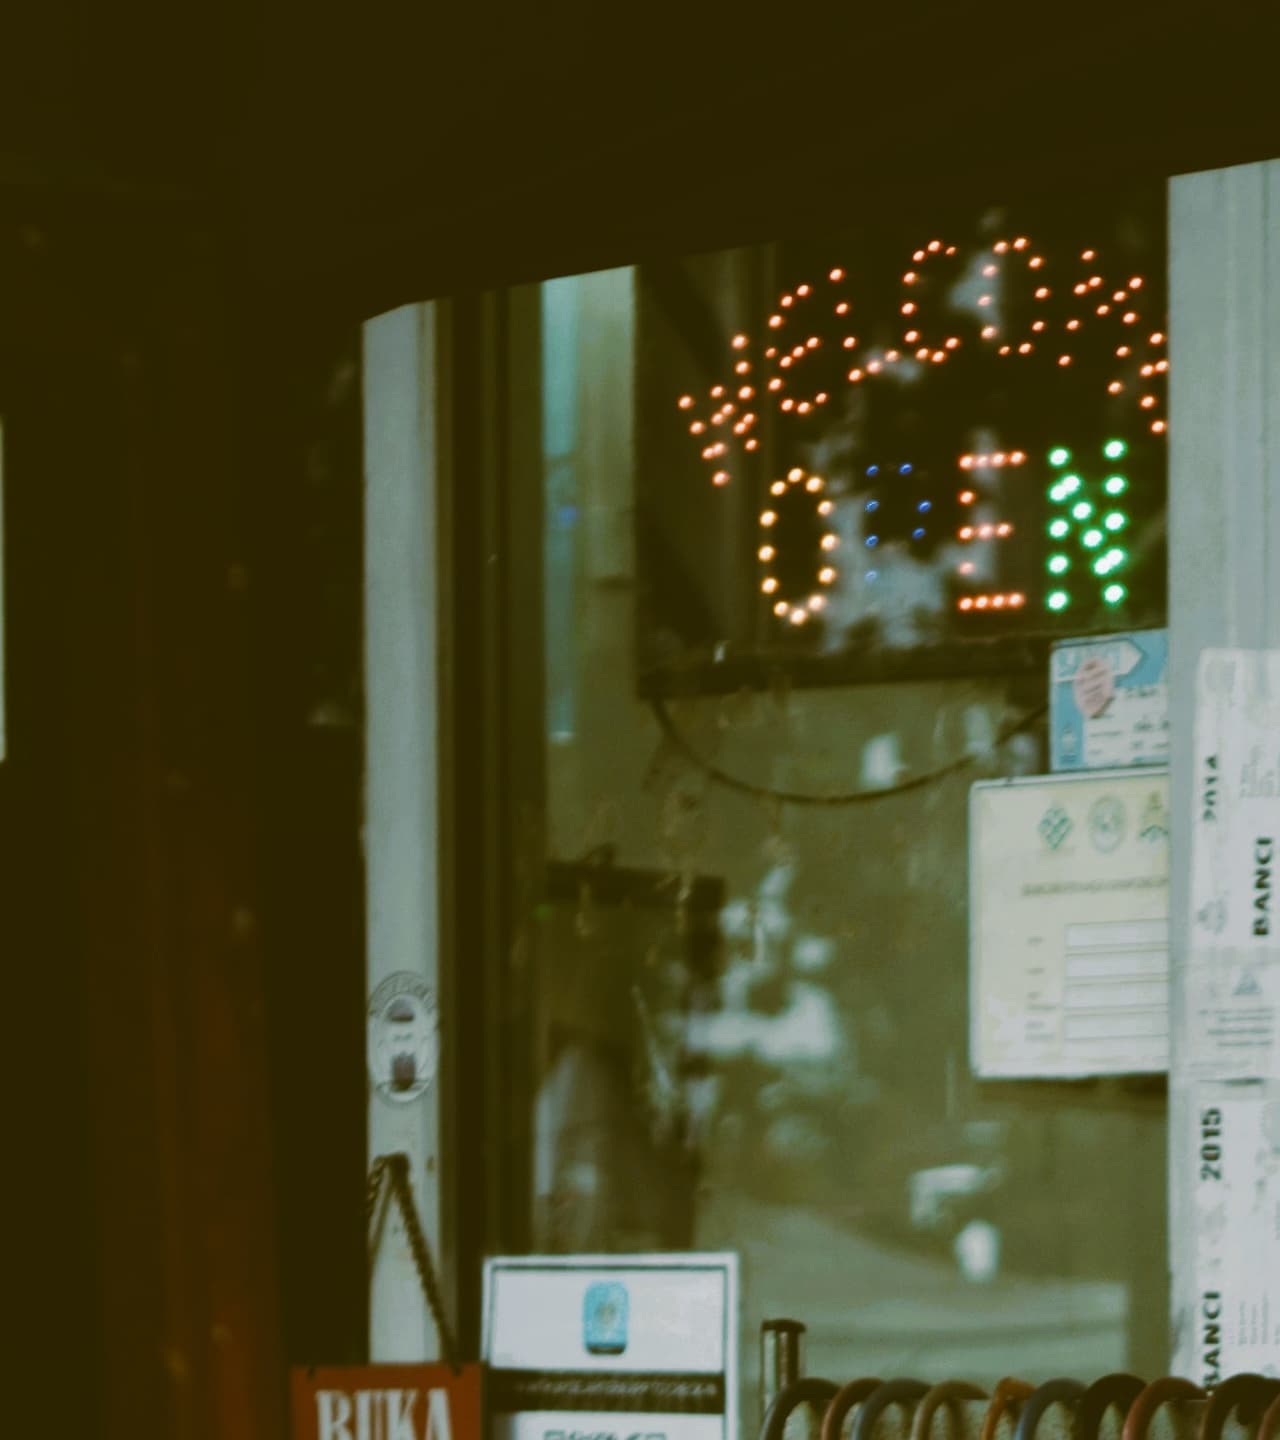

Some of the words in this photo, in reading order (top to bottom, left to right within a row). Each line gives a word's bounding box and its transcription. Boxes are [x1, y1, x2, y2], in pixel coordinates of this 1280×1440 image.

[758, 434, 1128, 625] OPEN
[1252, 836, 1273, 937] BANCI
[1199, 1106, 1222, 1182] 2015
